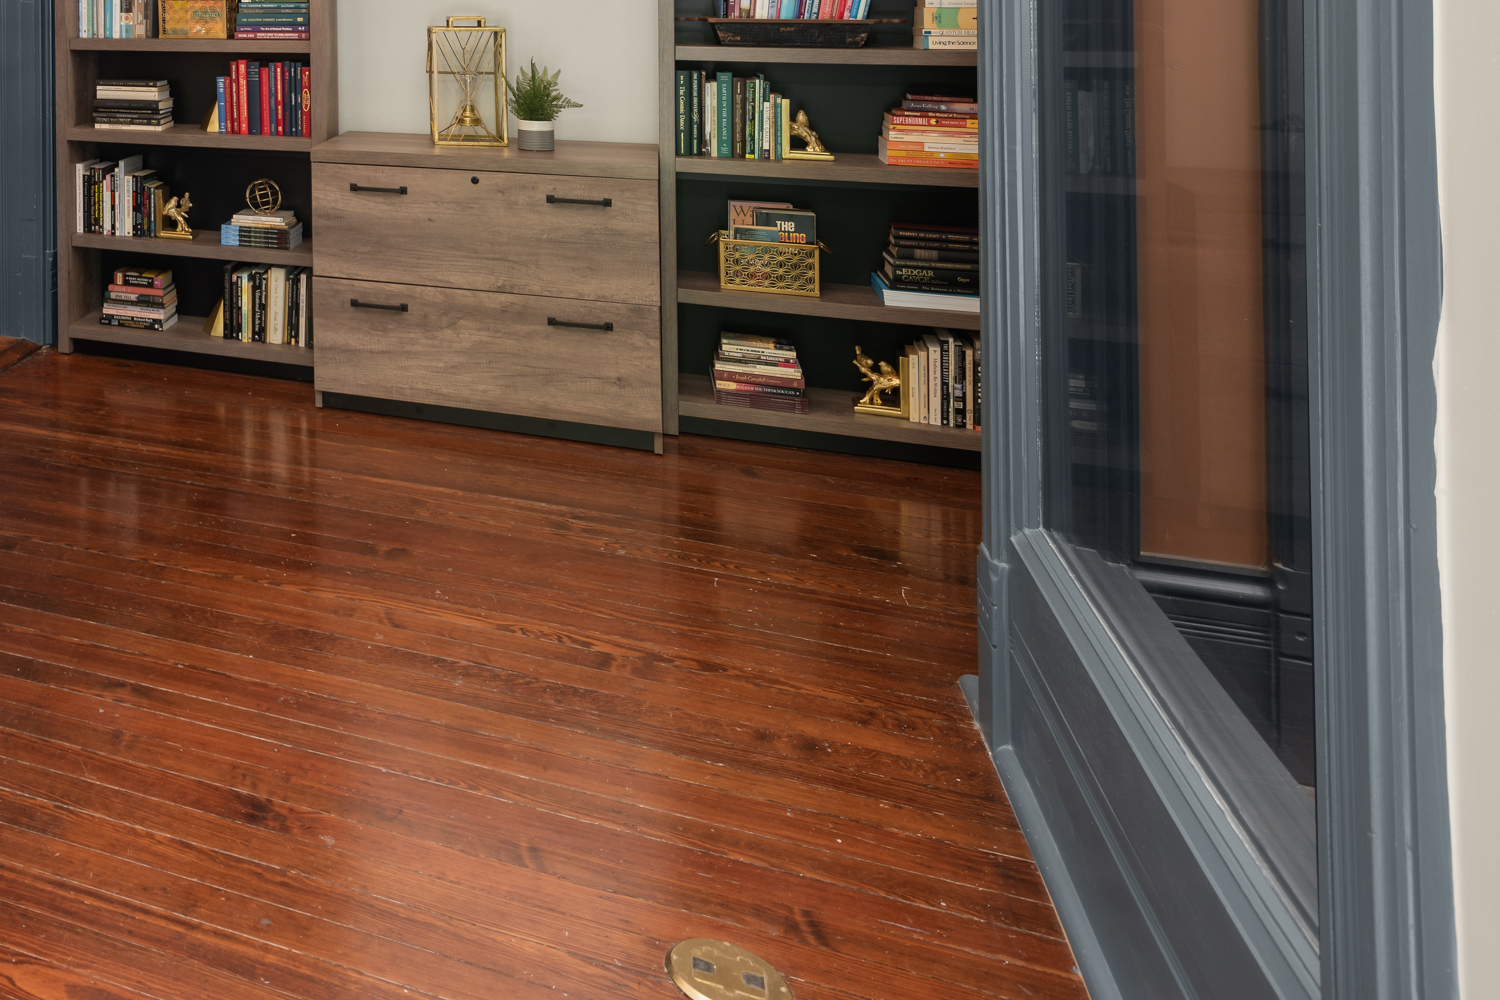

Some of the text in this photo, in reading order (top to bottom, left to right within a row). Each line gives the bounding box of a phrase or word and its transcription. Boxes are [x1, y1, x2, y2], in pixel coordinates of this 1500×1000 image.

[893, 116, 928, 125] SUPERNORMAL
[902, 268, 934, 277] EDGAR
[902, 275, 930, 283] CAYCE
